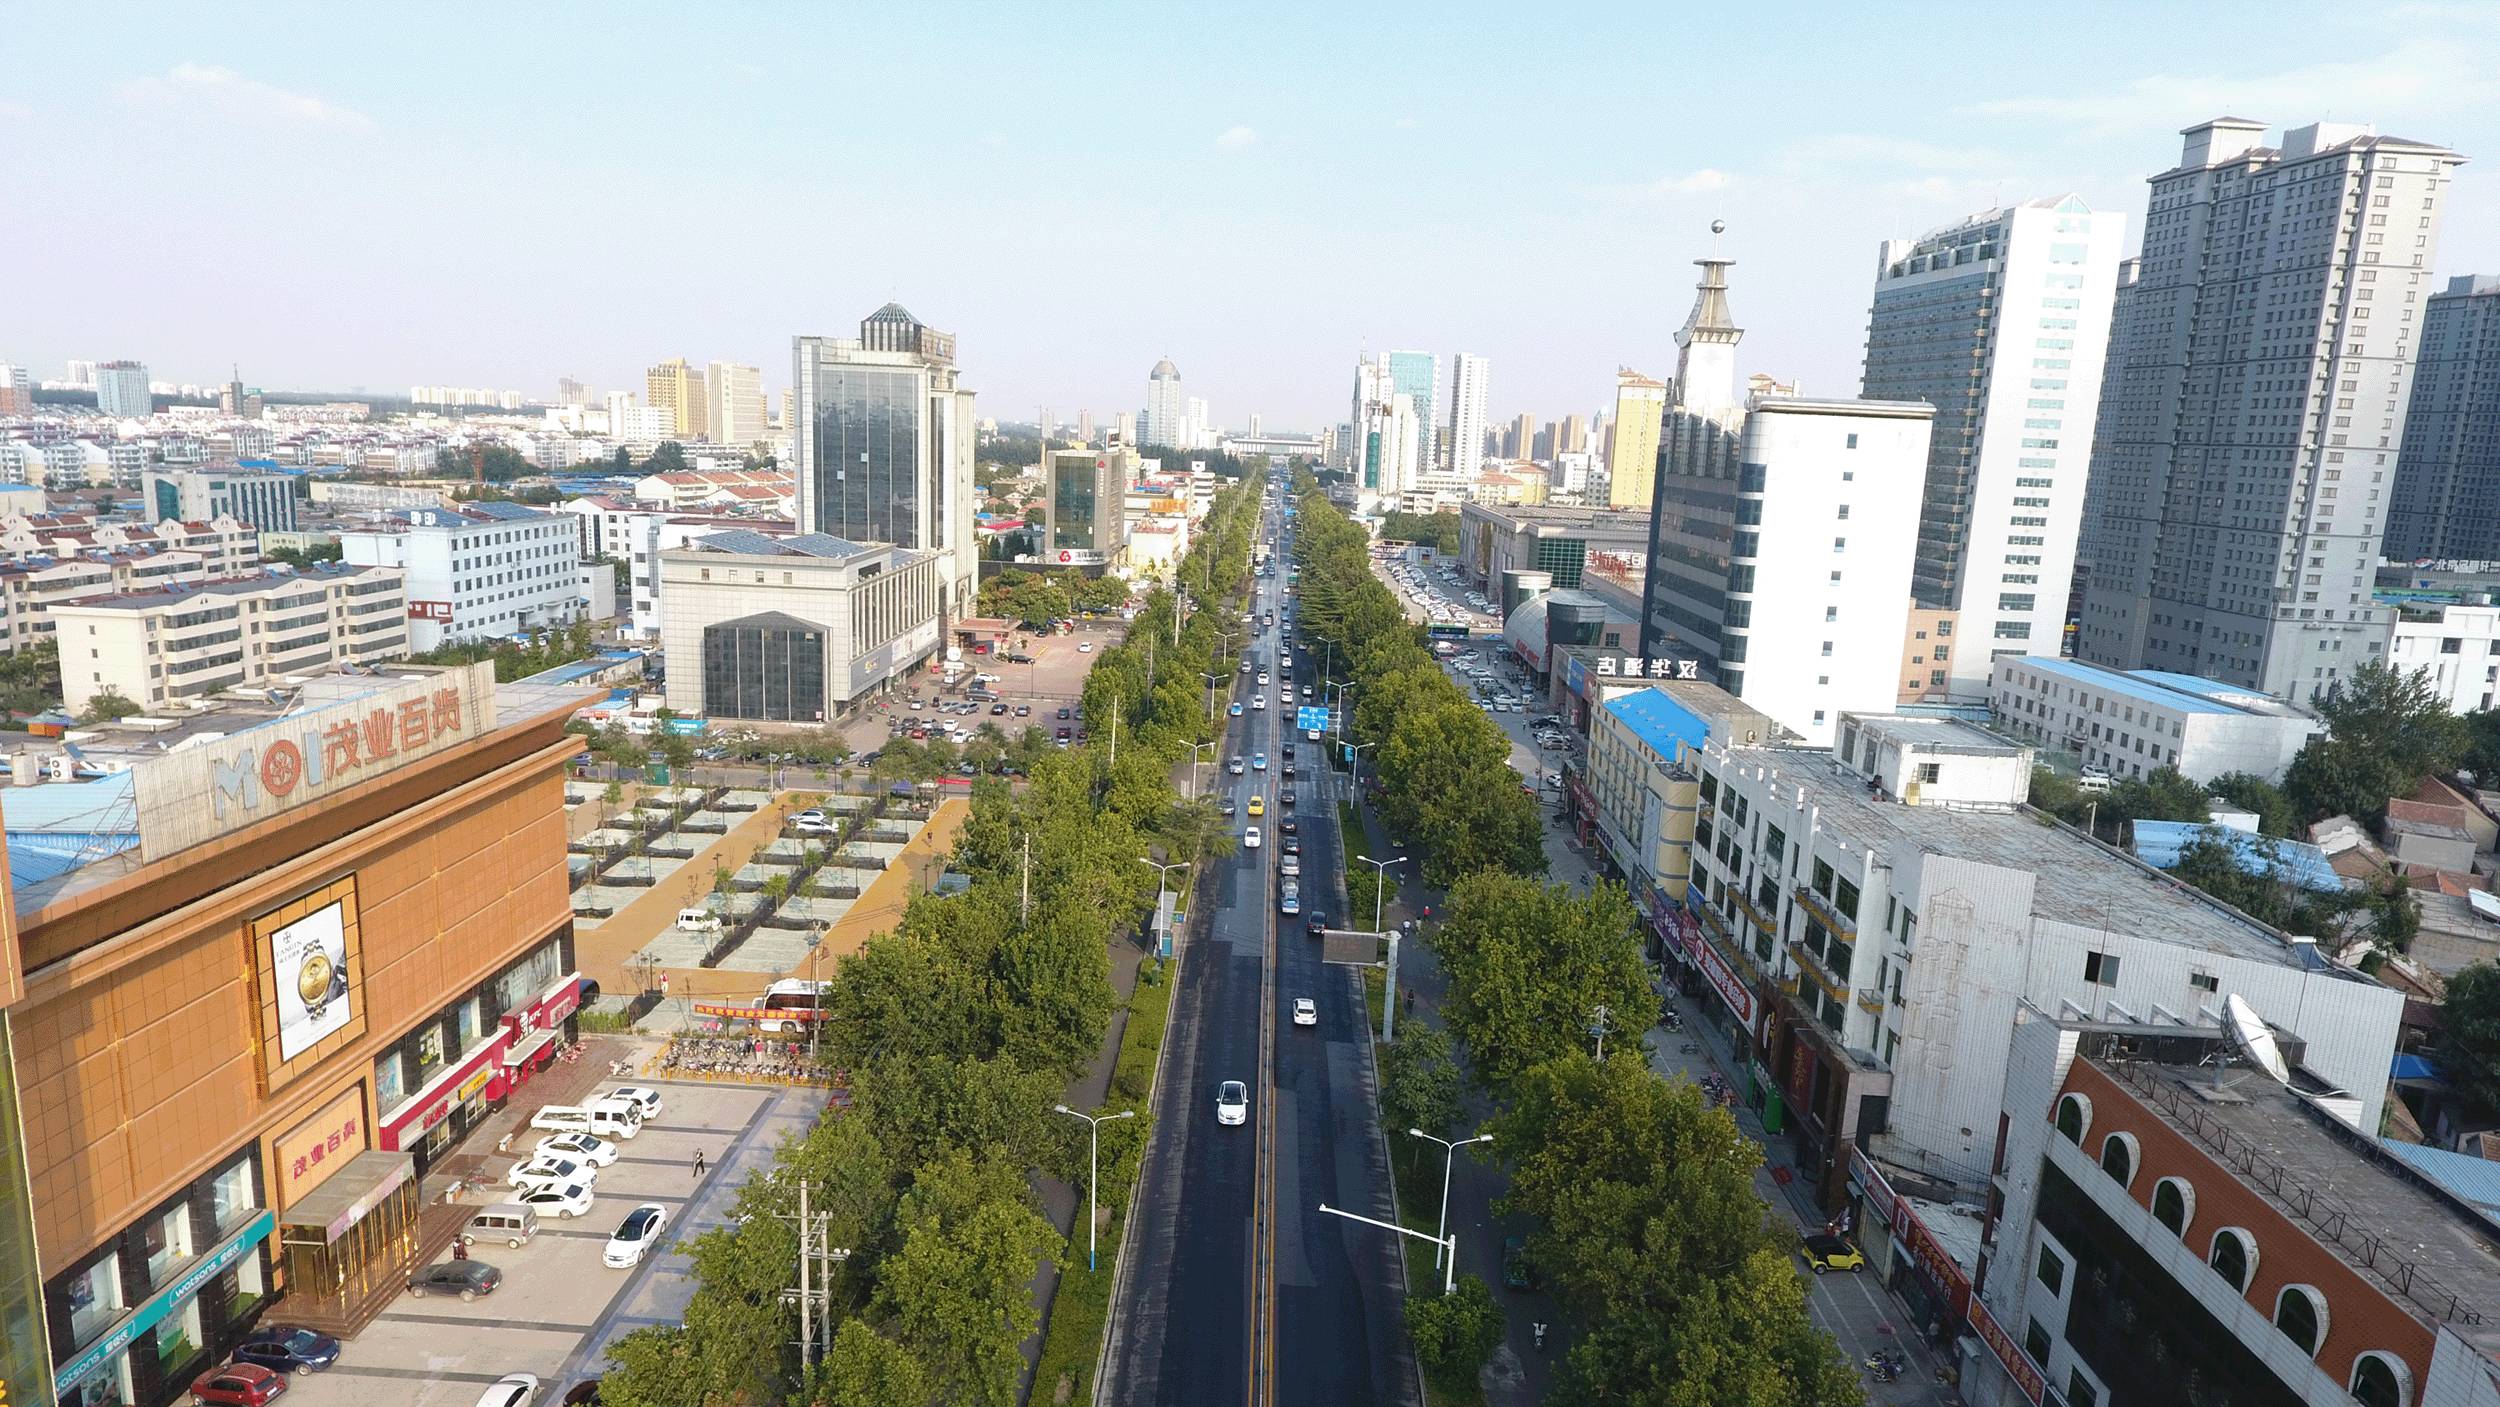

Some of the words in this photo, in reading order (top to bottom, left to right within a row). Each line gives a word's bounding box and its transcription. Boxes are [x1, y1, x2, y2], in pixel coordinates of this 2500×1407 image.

[323, 687, 462, 781] 茂业百货
[292, 1117, 357, 1180] 茂业百货
